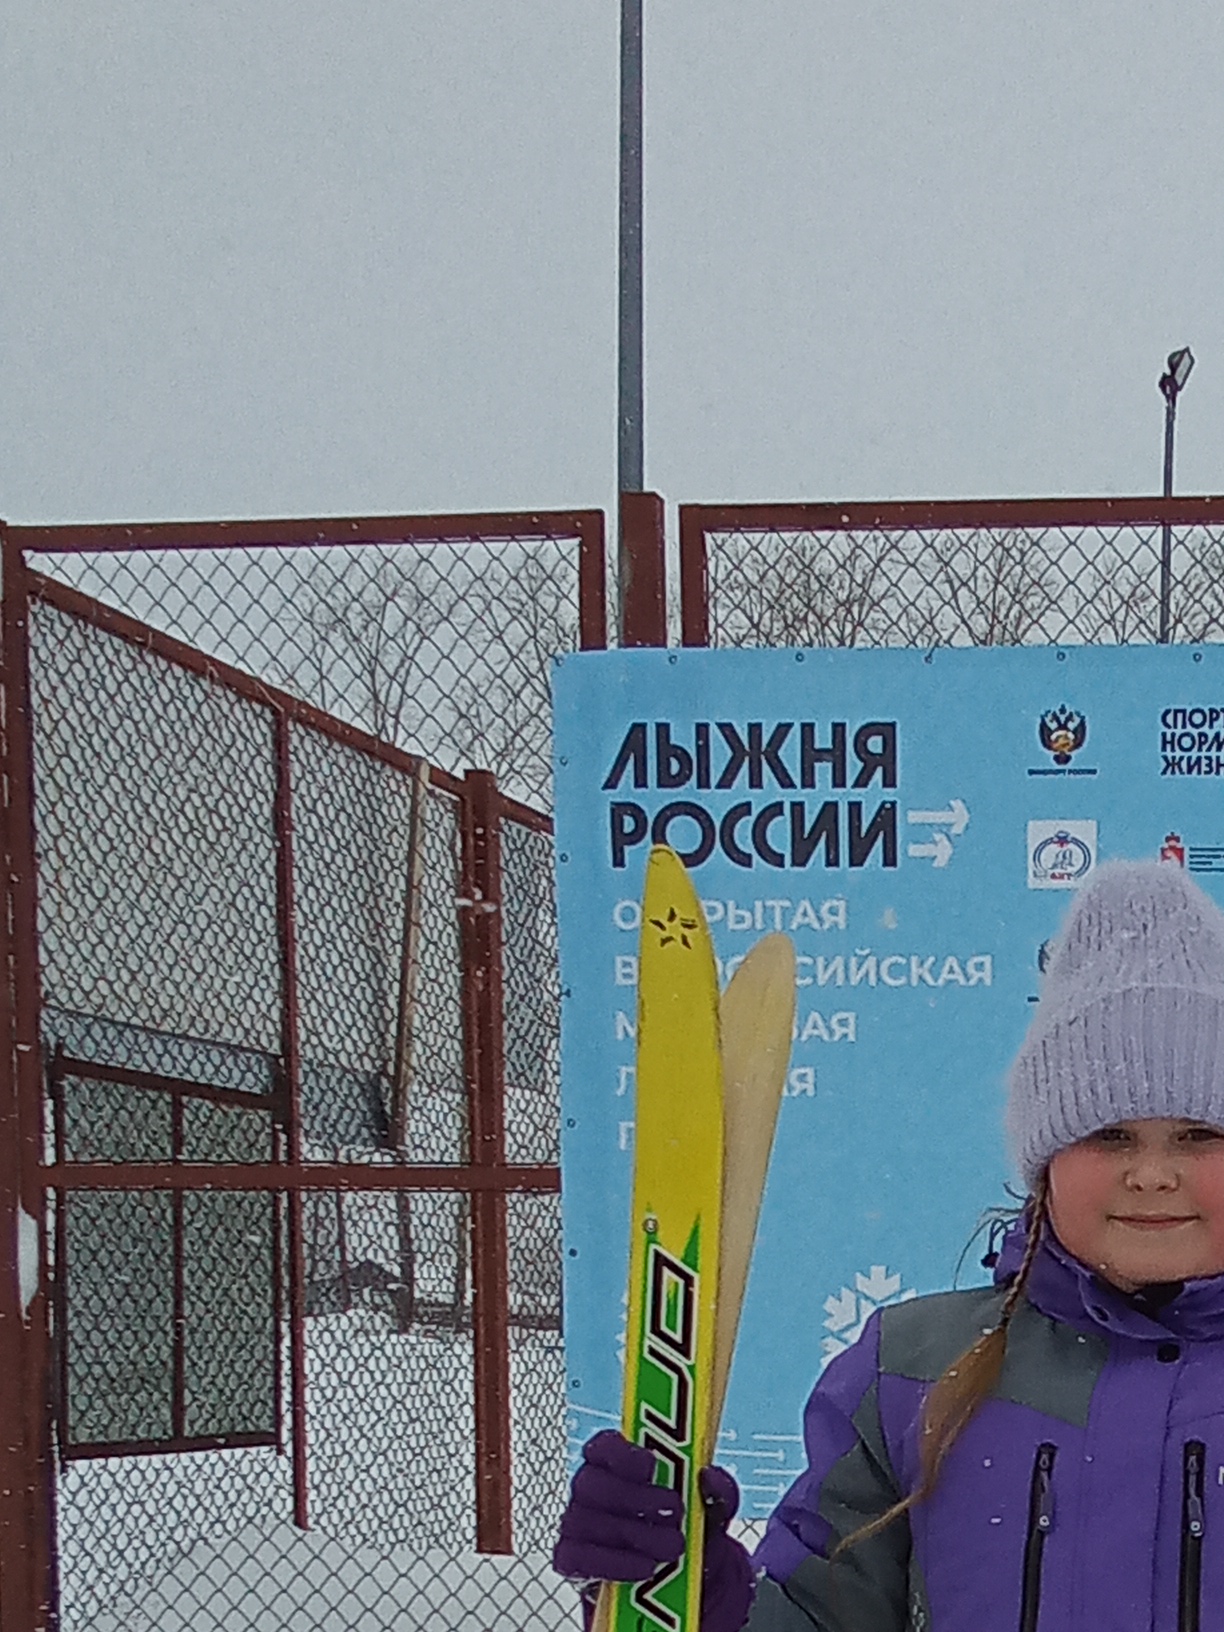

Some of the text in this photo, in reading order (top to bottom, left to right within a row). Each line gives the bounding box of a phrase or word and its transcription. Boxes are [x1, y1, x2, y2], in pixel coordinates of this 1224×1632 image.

[601, 721, 898, 790] ЛЫЖНЯ
[610, 800, 898, 869] РОССИИ
[613, 899, 848, 931] ОРЫТАЯ
